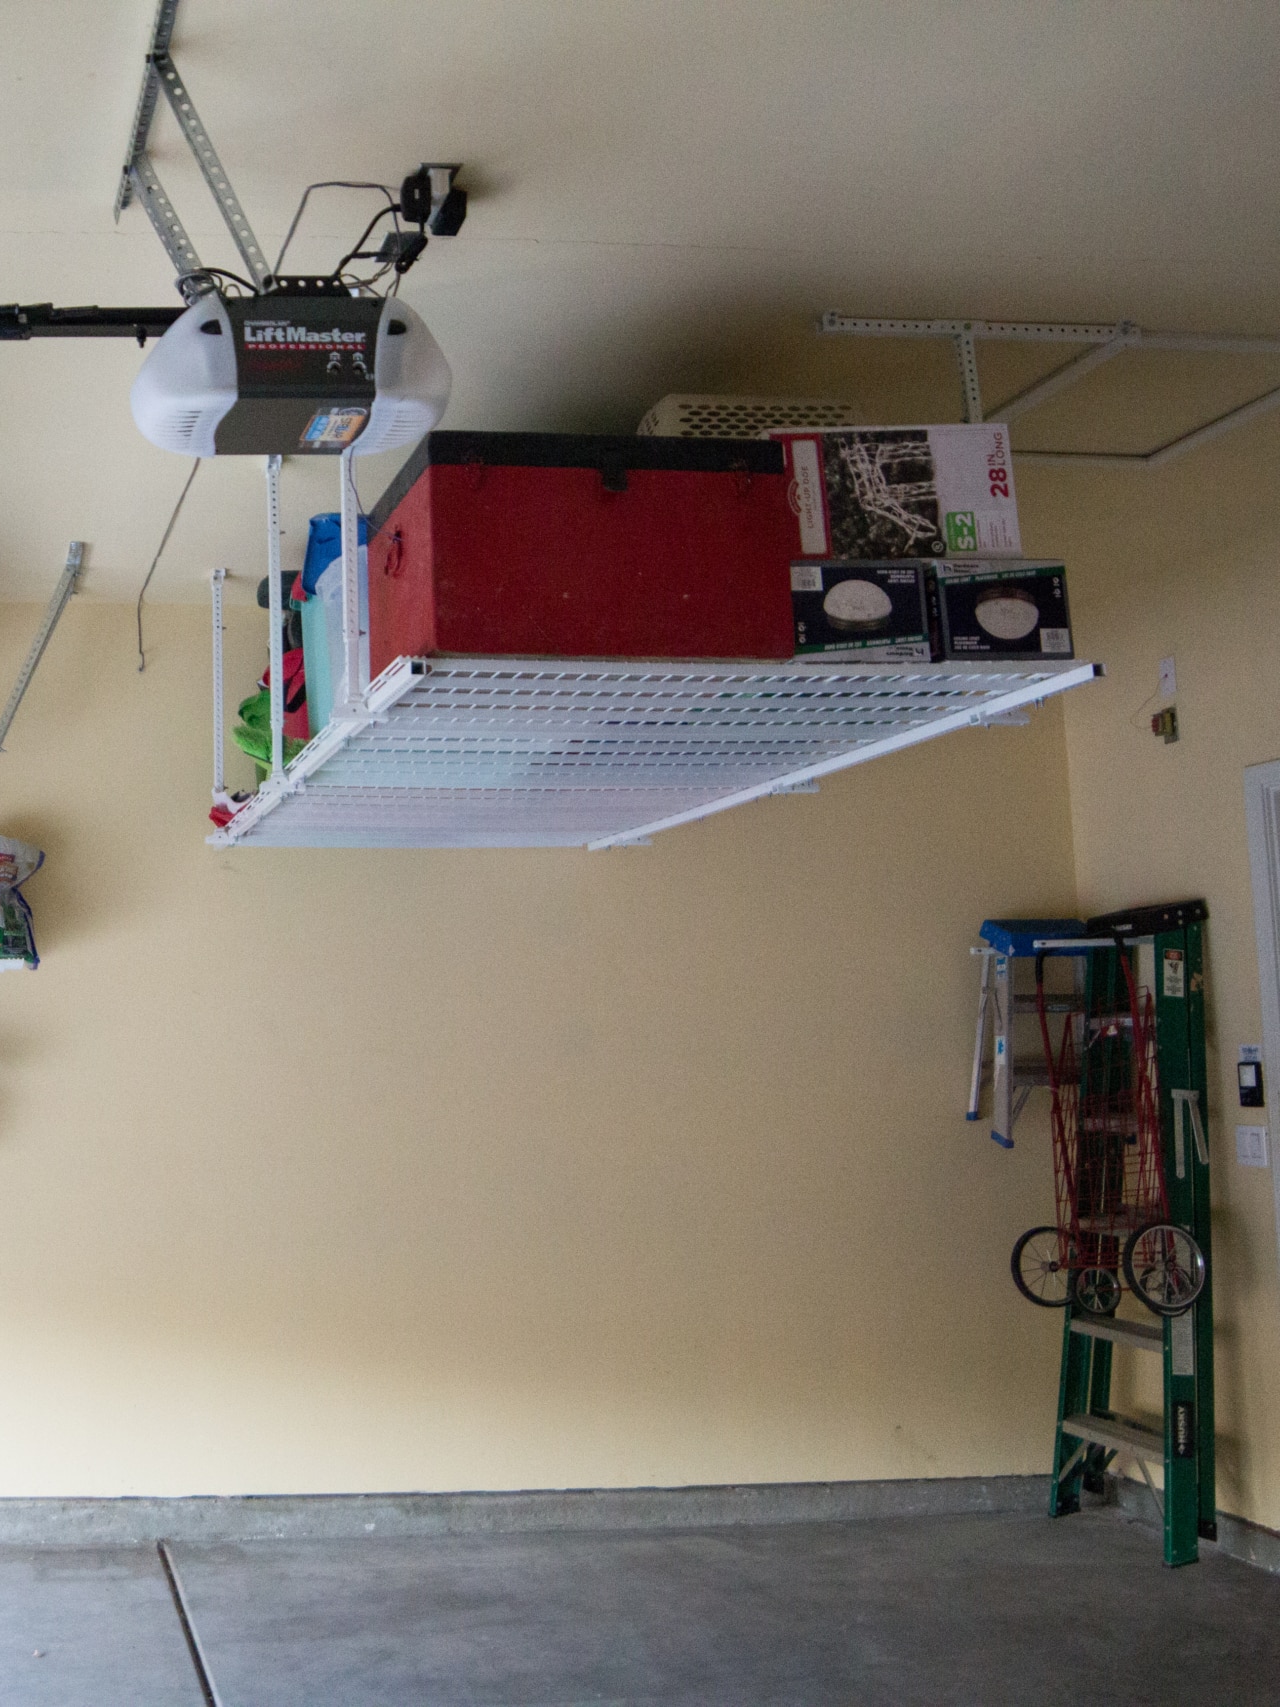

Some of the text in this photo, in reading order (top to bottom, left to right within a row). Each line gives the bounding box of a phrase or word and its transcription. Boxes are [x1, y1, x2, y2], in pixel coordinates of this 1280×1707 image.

[244, 326, 366, 343] LiftMaster
[986, 453, 997, 466] IN
[993, 431, 1006, 467] LONG
[801, 465, 814, 529] LIGHT-UP DOE
[988, 467, 1009, 498] 28
[955, 513, 975, 550] S-2
[1177, 1405, 1185, 1443] HUSKY
